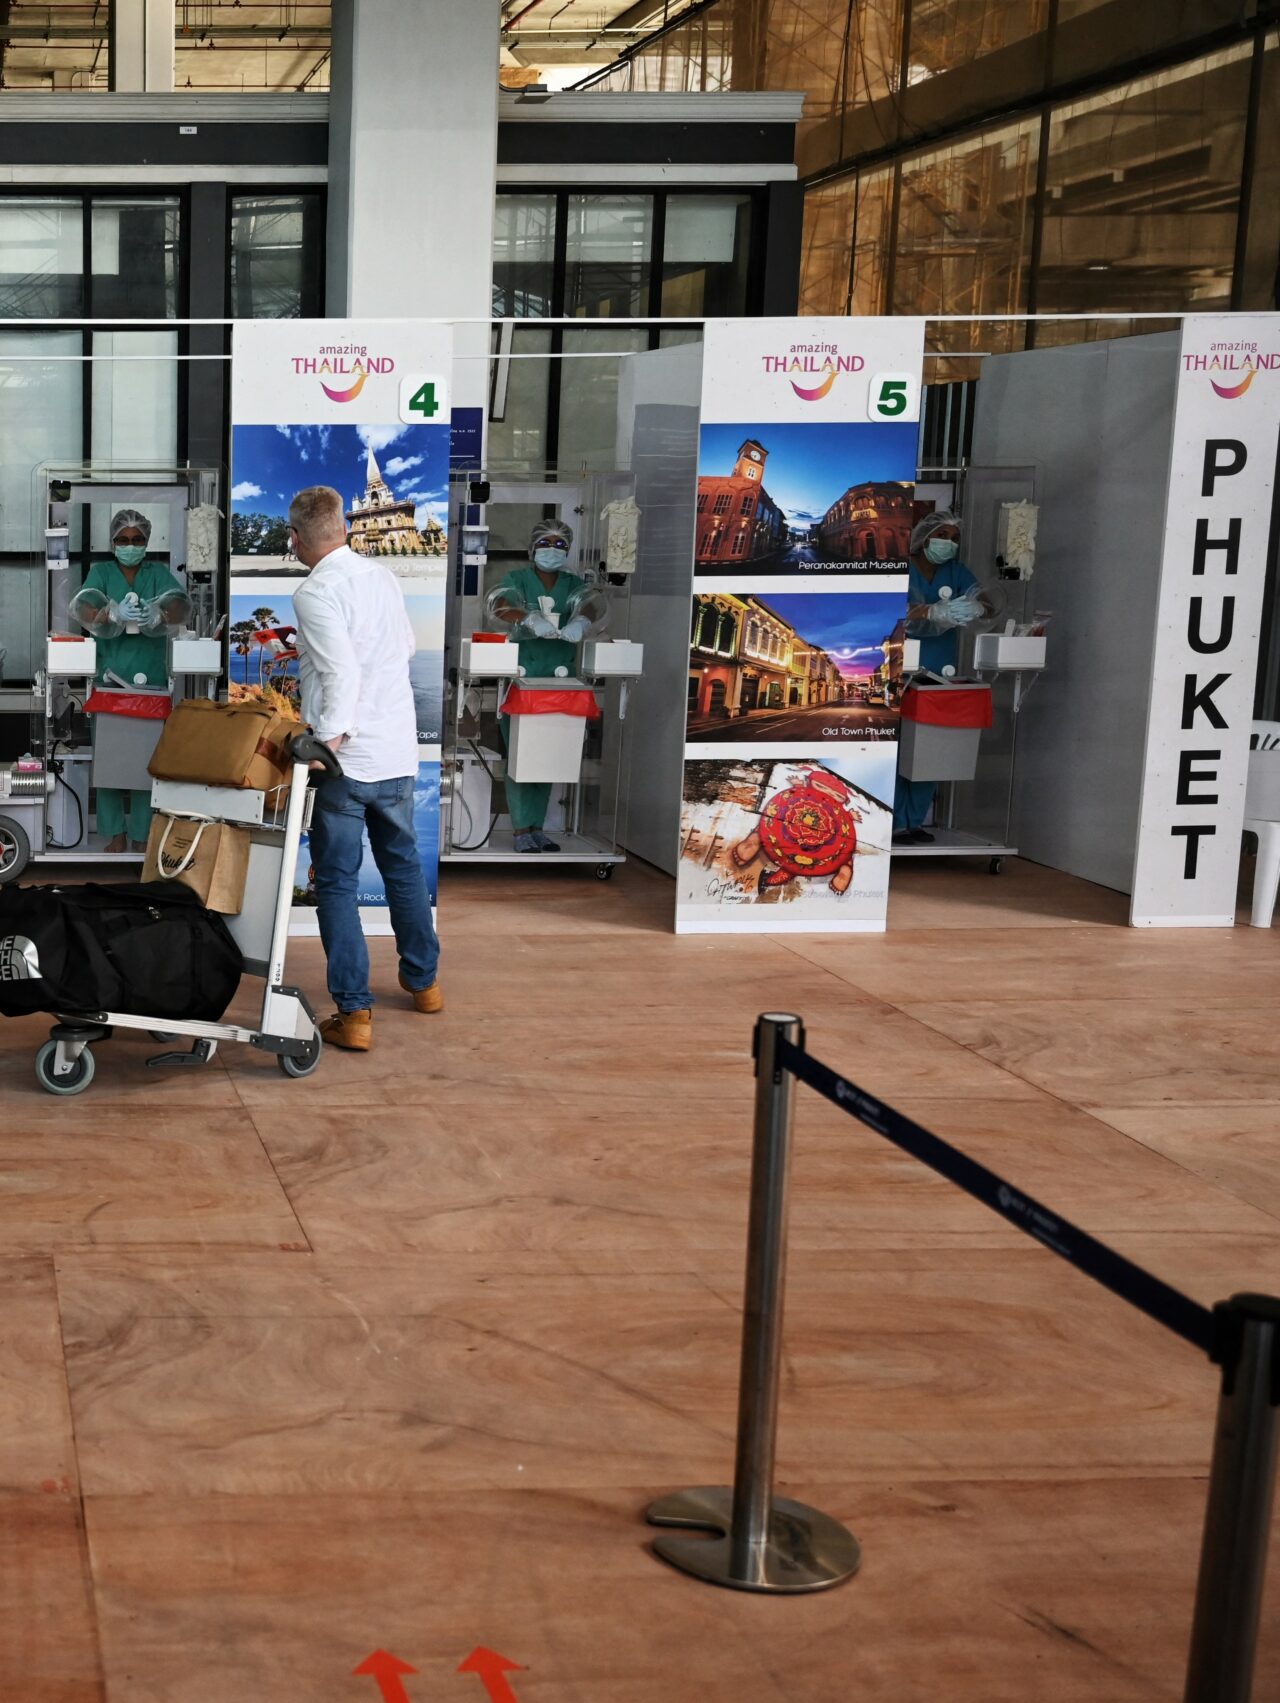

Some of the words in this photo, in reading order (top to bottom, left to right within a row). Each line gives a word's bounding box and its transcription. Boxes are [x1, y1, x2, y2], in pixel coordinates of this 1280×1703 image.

[319, 344, 367, 356] amazing
[790, 342, 838, 355] amazing
[1210, 340, 1258, 353] amazing
[291, 358, 395, 374] THAILAND
[762, 356, 865, 372] THAILAND
[409, 382, 439, 417] 4
[877, 381, 907, 416] 5
[869, 561, 908, 570] Museum
[1171, 439, 1248, 880] PHUKET
[416, 730, 438, 739] ape
[822, 727, 839, 736] Old
[840, 727, 863, 736] Town
[865, 727, 896, 736] Phuket
[156, 851, 196, 871] Phukt
[363, 893, 386, 901] Rock
